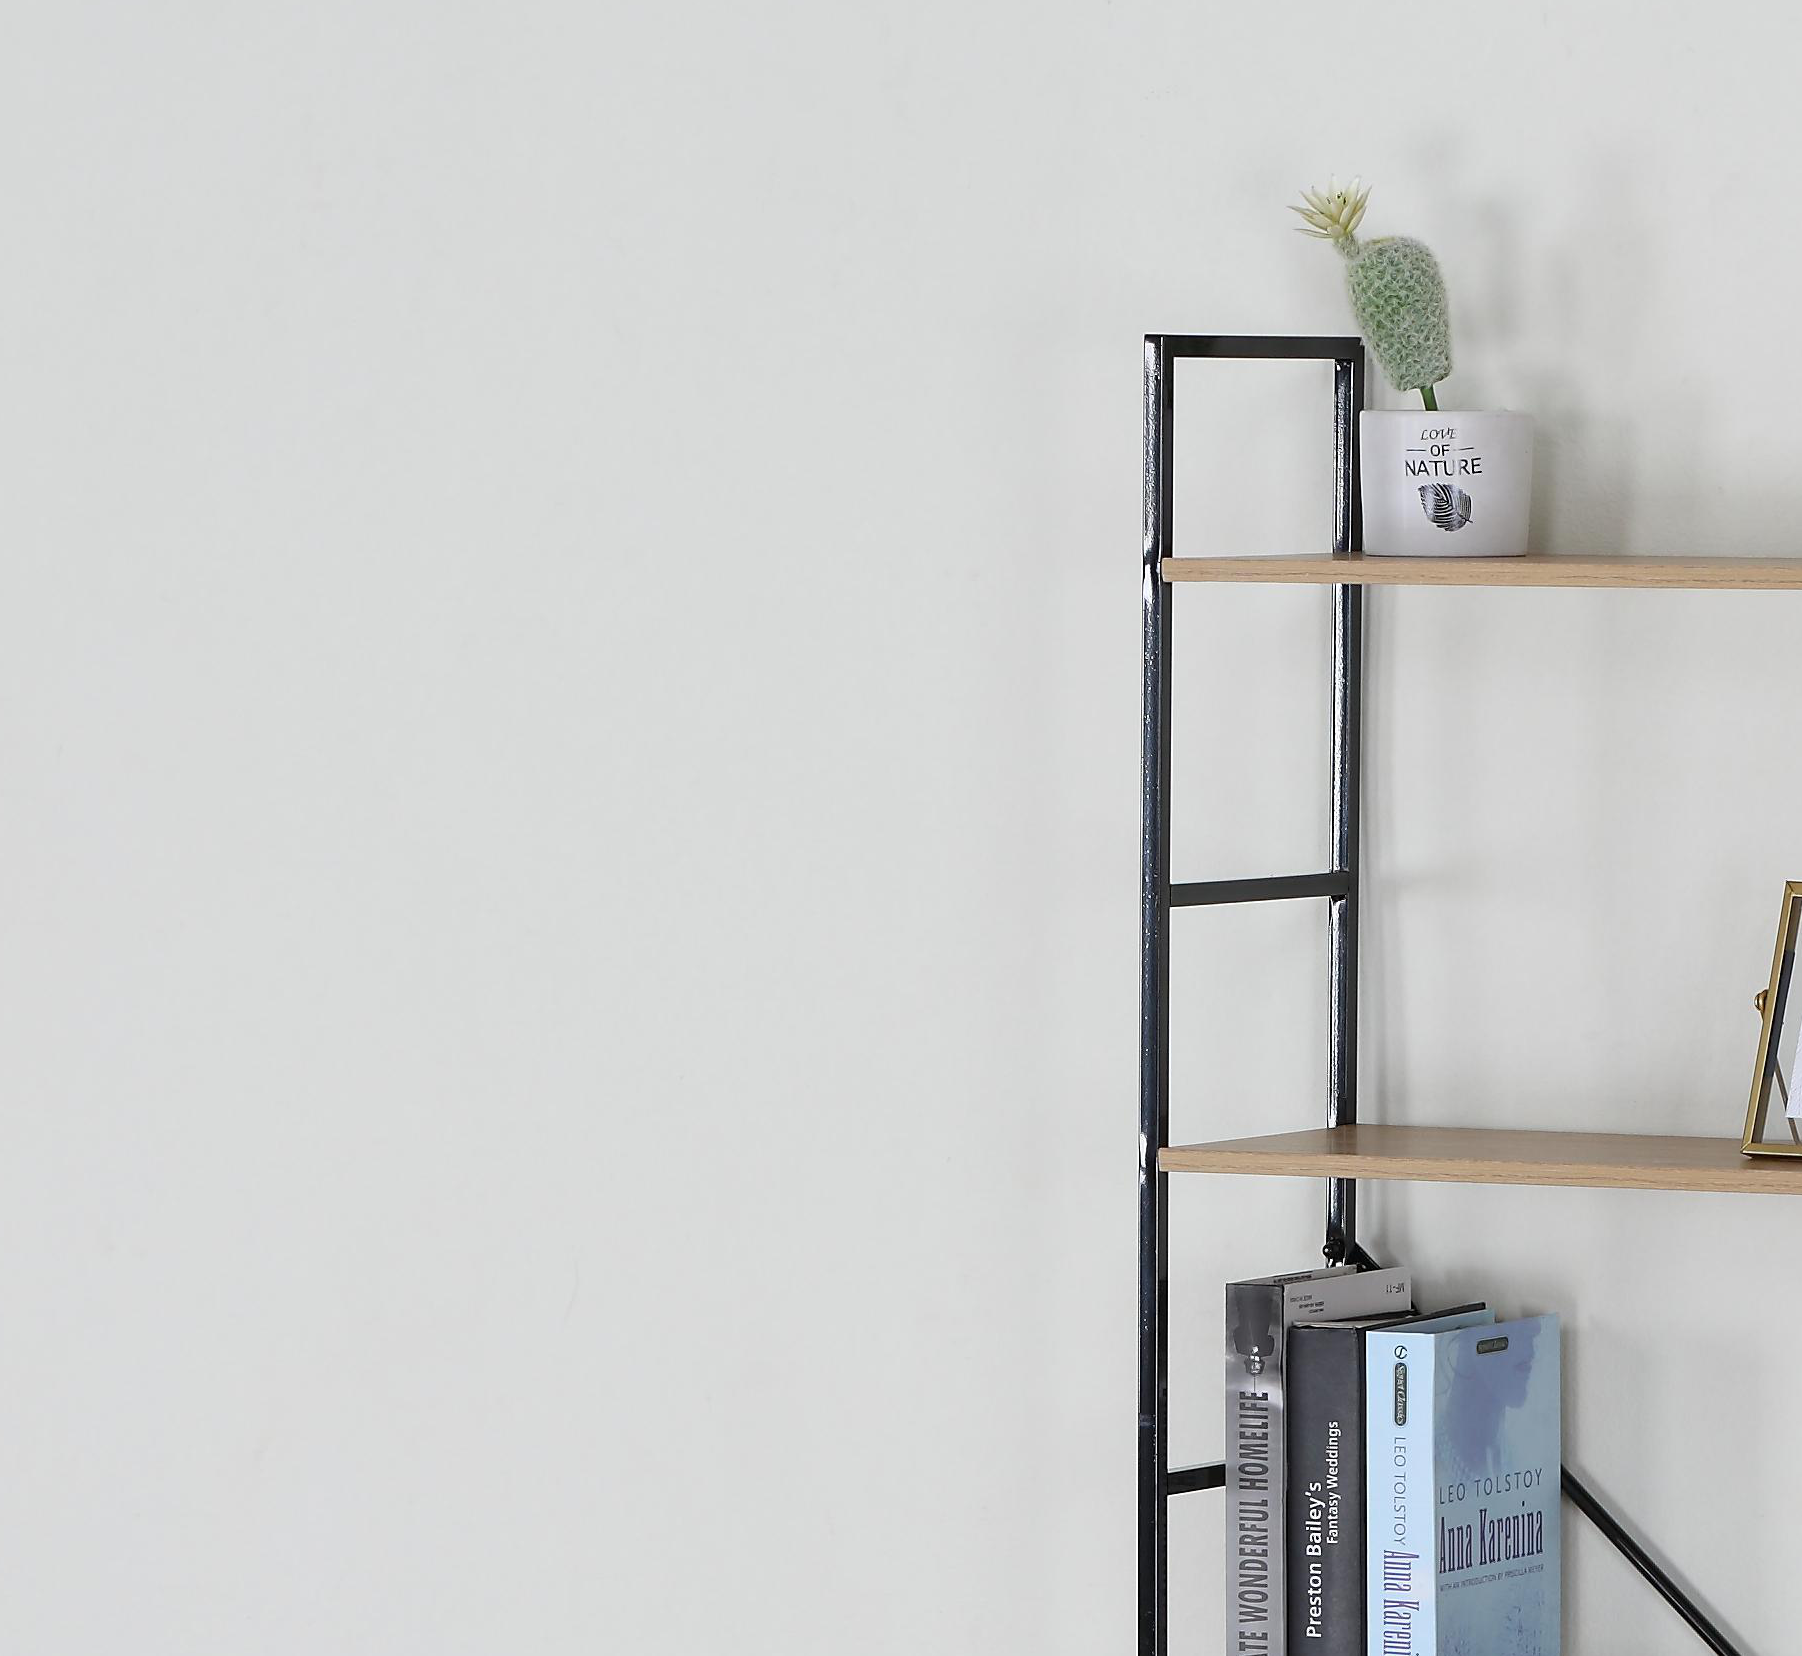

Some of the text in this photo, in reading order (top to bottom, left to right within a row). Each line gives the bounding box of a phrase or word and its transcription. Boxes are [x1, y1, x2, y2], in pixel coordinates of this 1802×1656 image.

[1405, 457, 1482, 477] NATURE
[1421, 428, 1457, 440] LOVE
[1430, 444, 1450, 457] OF
[1238, 1391, 1268, 1491] HOMELIFE
[1326, 1421, 1341, 1544] Fantasy Weddings
[1394, 1437, 1406, 1545] LEO TOLSTOY
[1439, 1468, 1542, 1504] LEO TOLSTOY
[1238, 1499, 1268, 1623] WONDERFUL
[1305, 1482, 1325, 1638] Preston Bailey's
[1383, 1550, 1420, 1591] Anna
[1439, 1500, 1543, 1574] Anna Karenina
